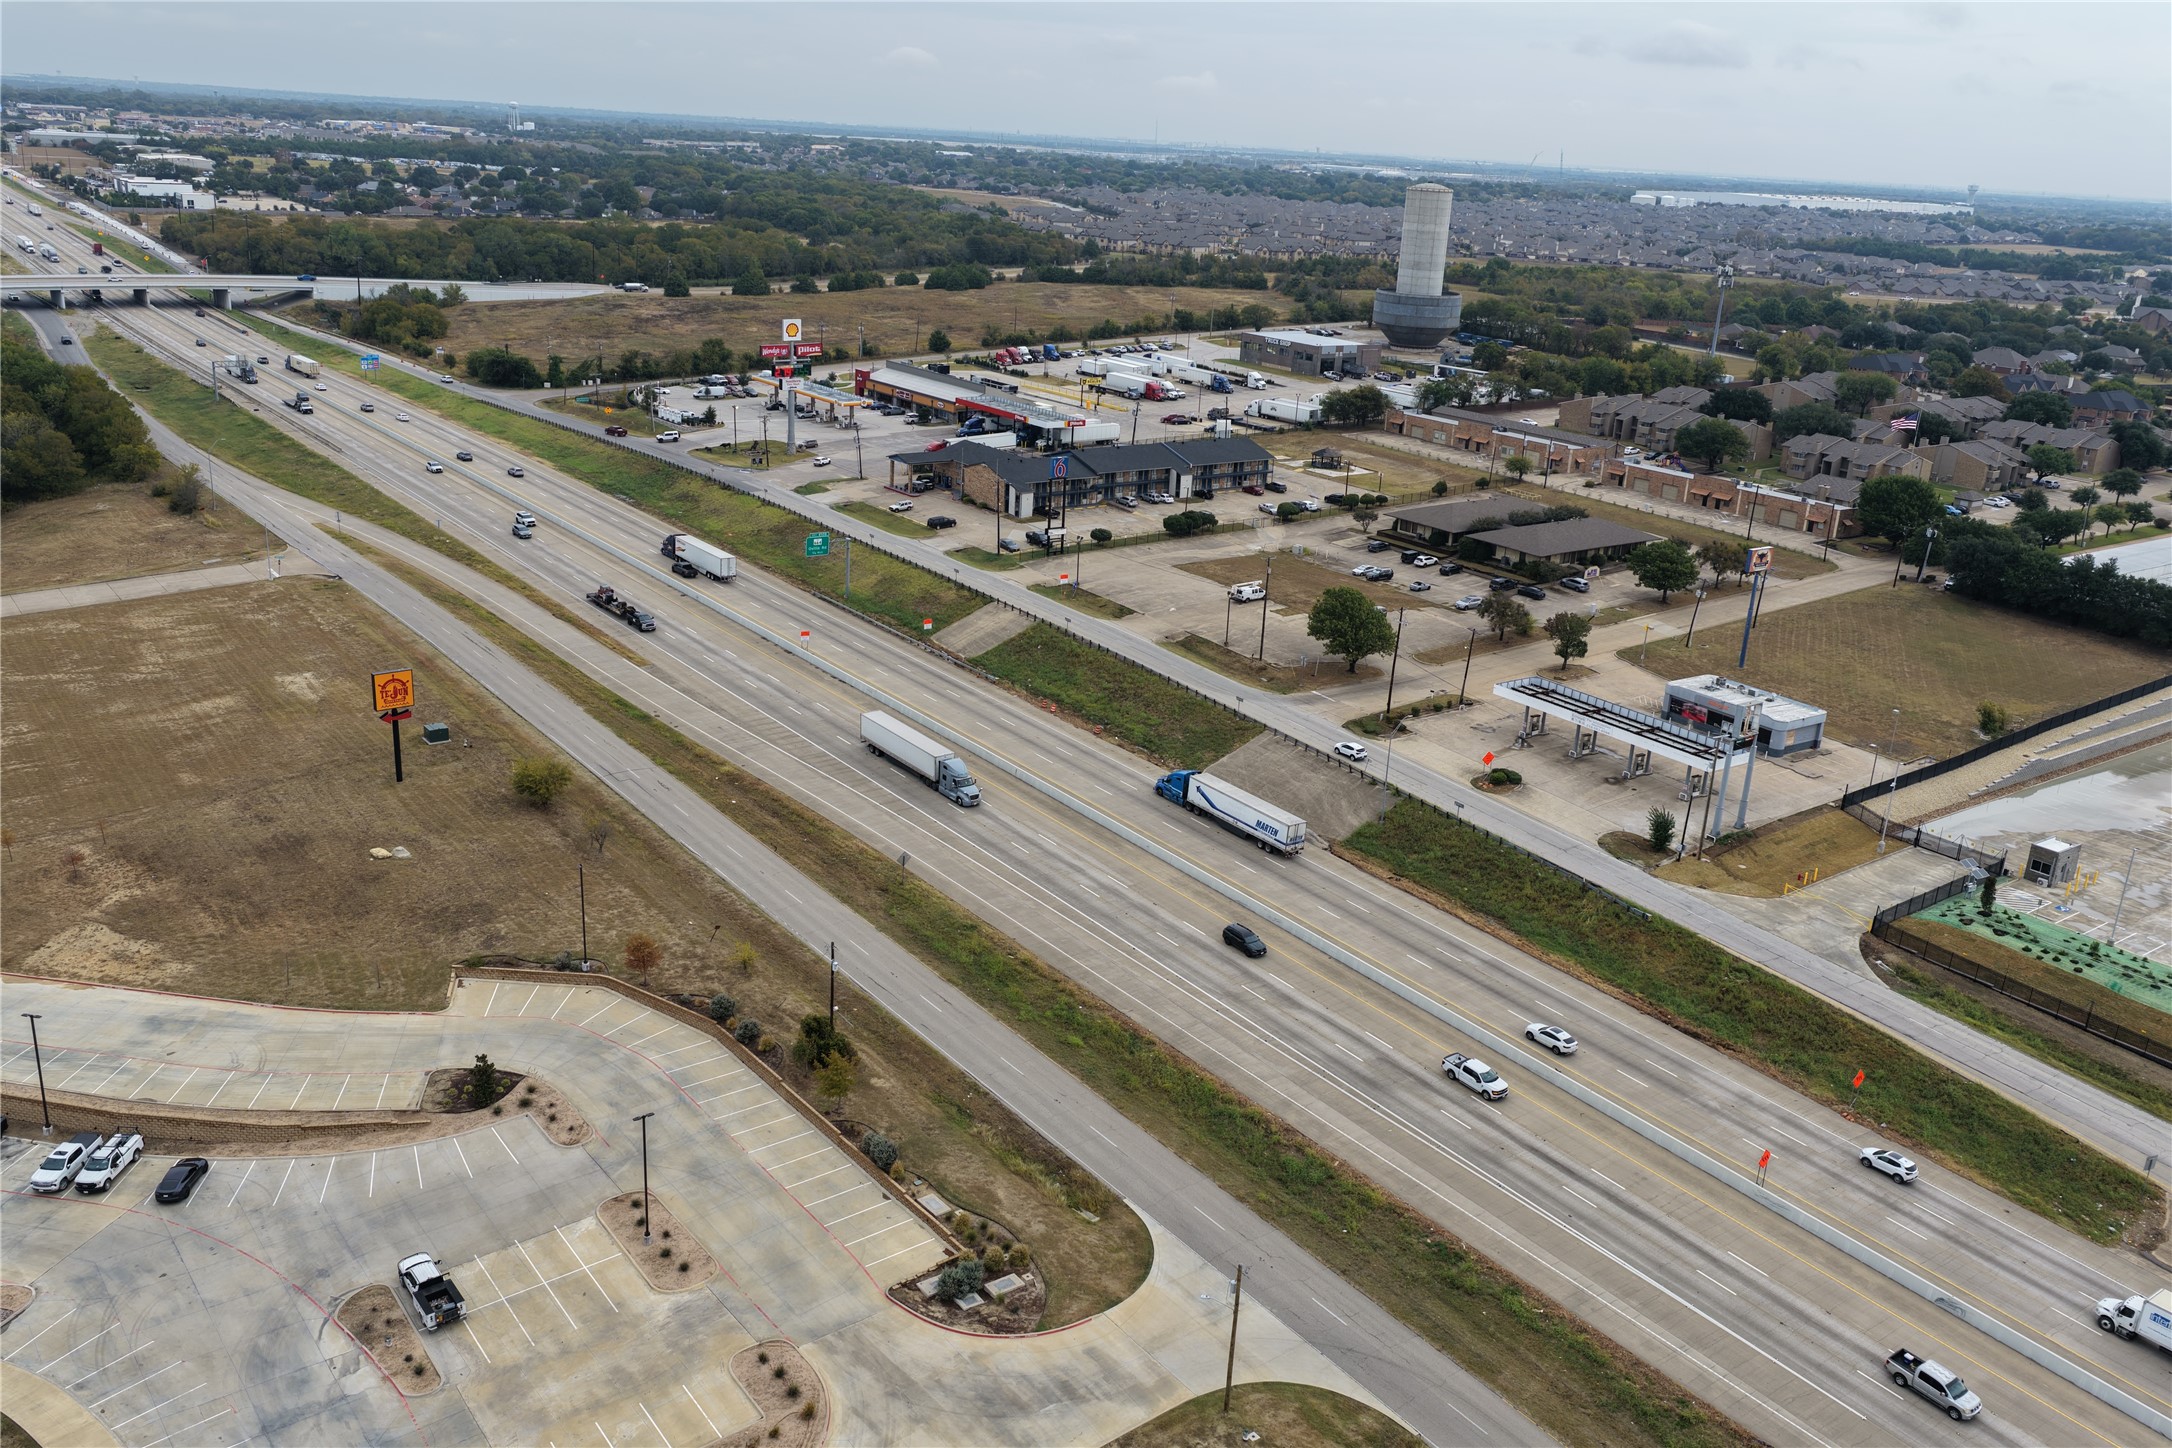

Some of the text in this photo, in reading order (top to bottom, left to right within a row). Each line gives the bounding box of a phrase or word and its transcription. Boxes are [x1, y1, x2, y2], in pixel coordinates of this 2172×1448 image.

[1279, 339, 1291, 347] SHOP
[762, 348, 780, 356] Wendy's
[1054, 458, 1066, 478] 6
[1255, 819, 1279, 837] MARTEN
